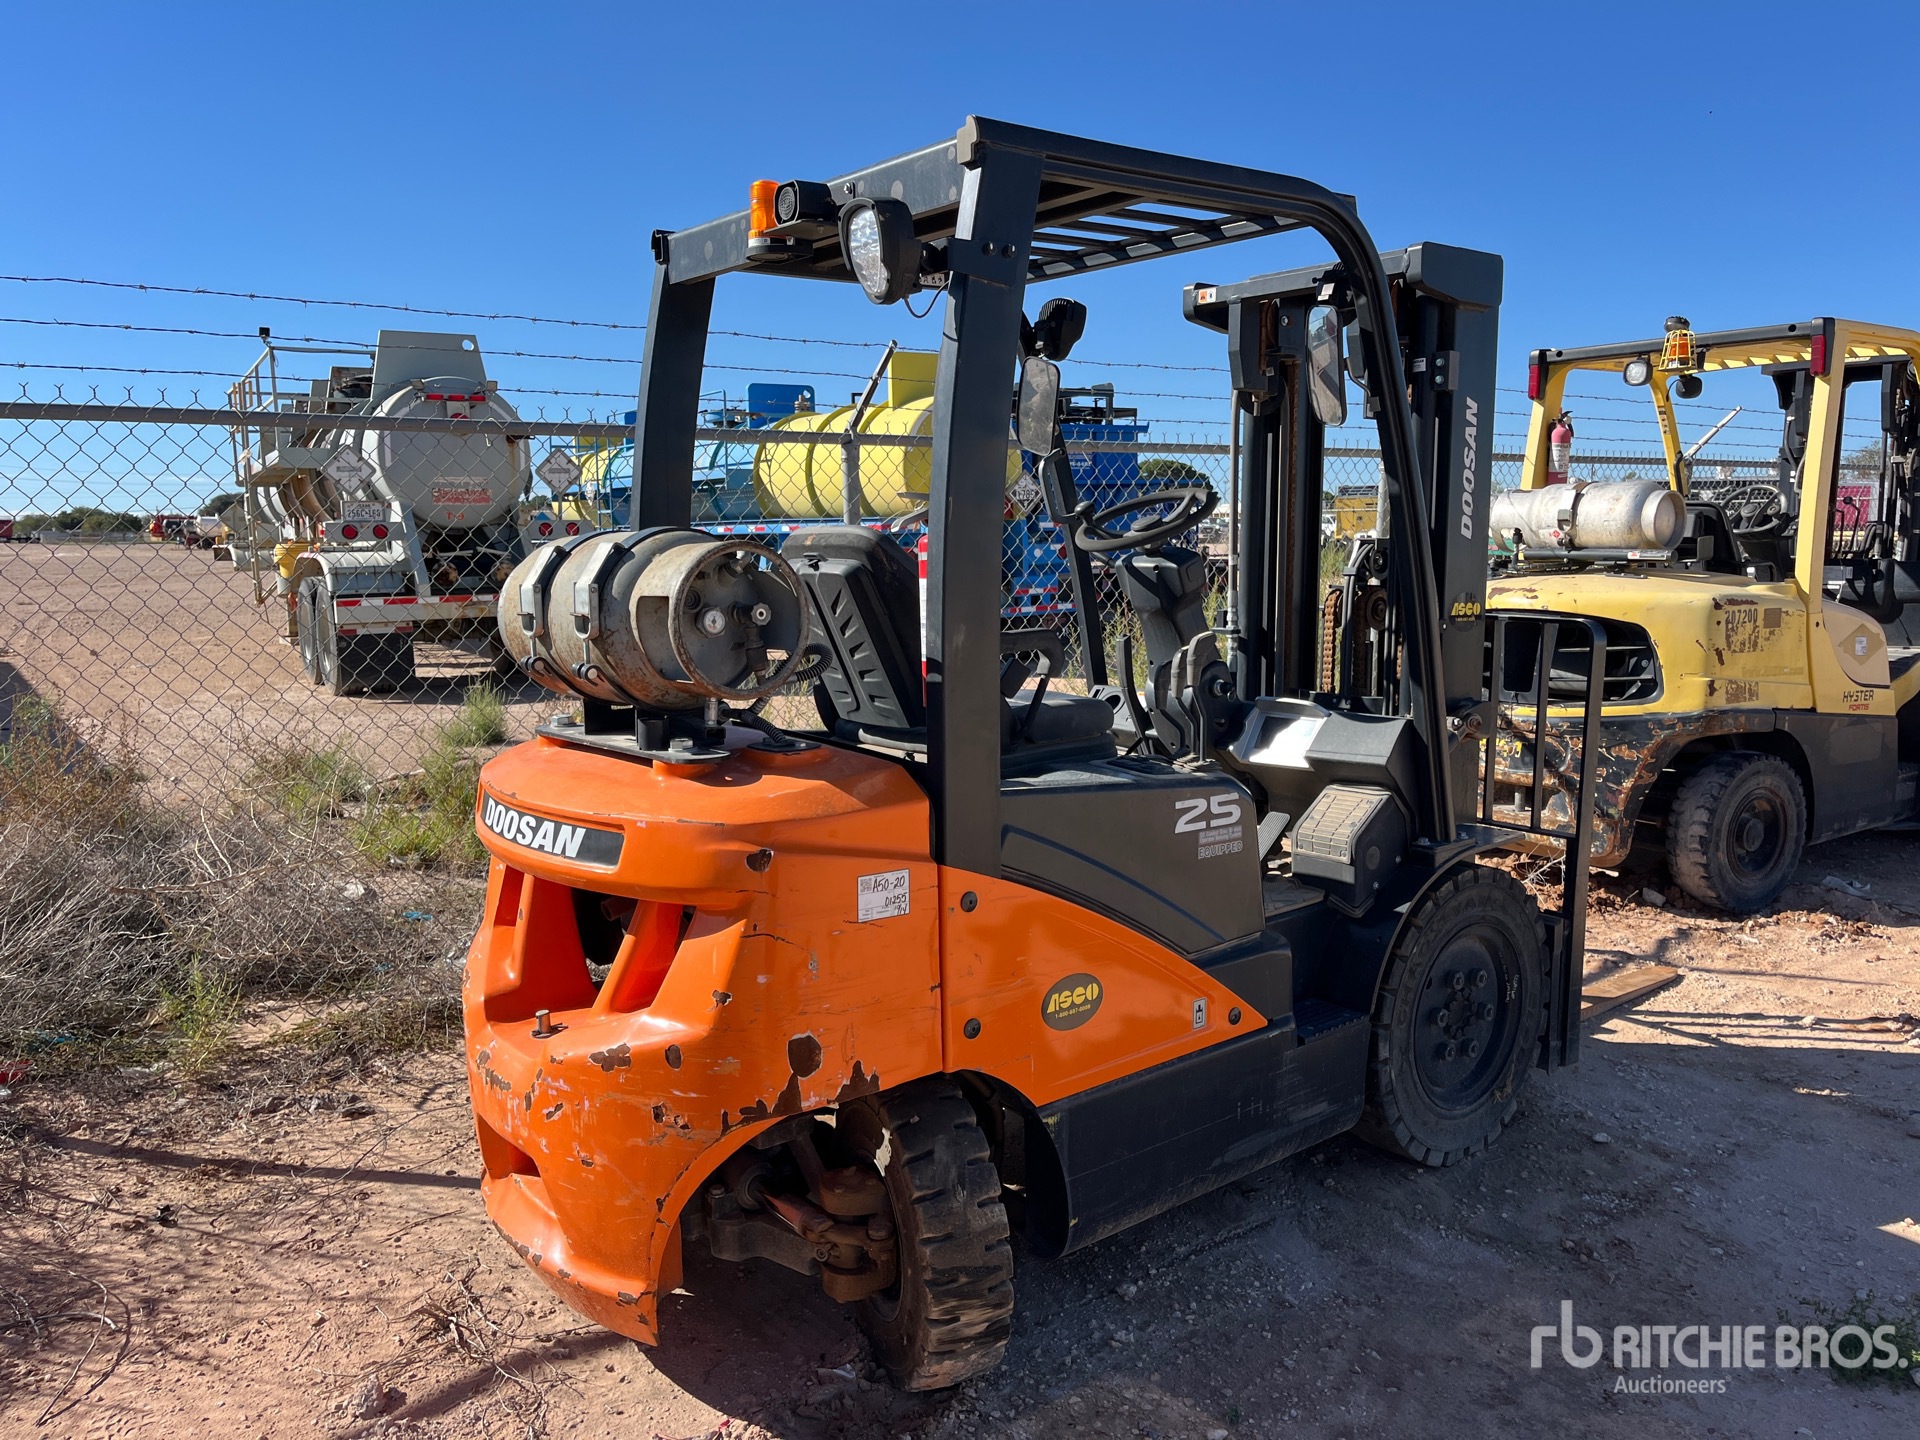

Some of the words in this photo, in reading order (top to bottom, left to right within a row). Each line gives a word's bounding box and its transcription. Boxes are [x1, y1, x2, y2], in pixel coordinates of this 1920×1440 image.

[1461, 397, 1478, 539] DOOSAN
[1450, 602, 1481, 616] ASCO
[1725, 608, 1758, 626] 207200
[1842, 689, 1875, 703] HYSTER
[1848, 703, 1870, 712] FORTIS
[1174, 792, 1241, 834] 25
[485, 797, 587, 858] DOOSAN
[1198, 840, 1243, 860] EQUIPPED
[872, 875, 906, 892] A50-20
[1046, 983, 1099, 1014] ASCO
